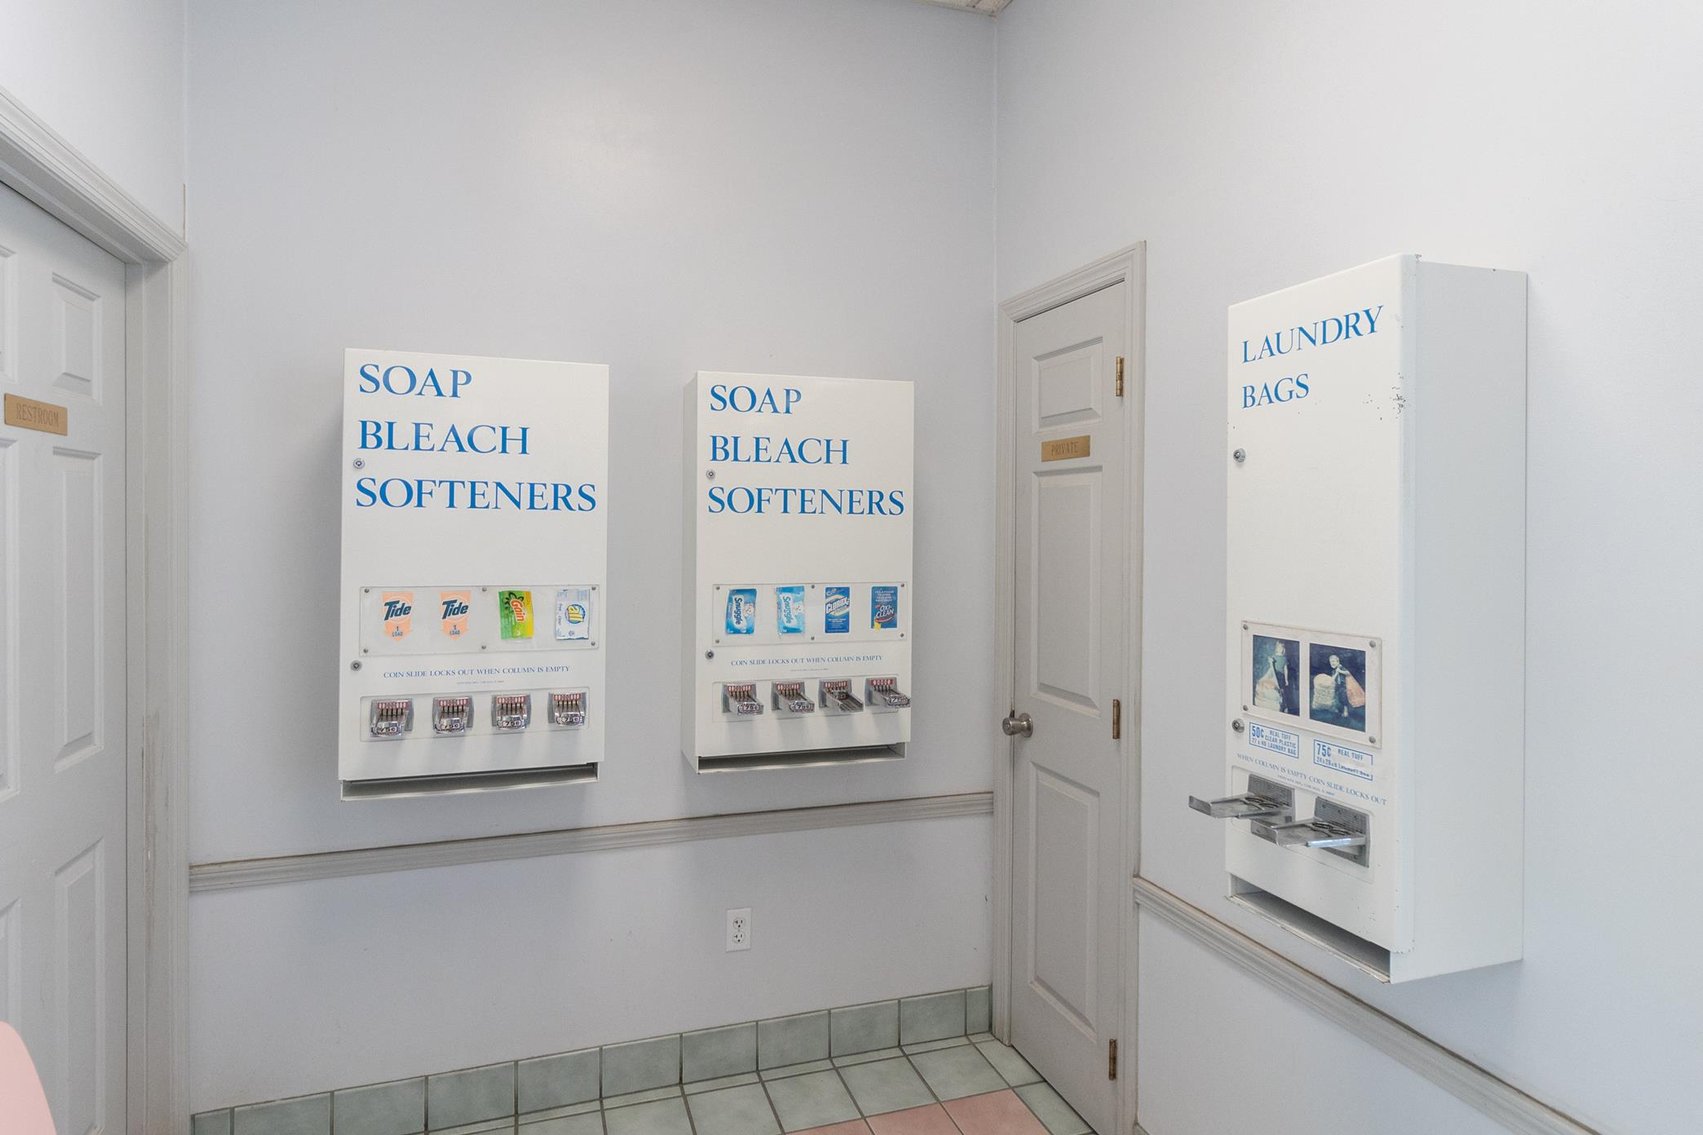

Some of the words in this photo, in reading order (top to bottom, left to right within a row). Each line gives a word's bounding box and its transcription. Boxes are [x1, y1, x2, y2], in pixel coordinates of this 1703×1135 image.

[1241, 304, 1384, 363] LAUNDRY
[359, 363, 472, 398] SOAP
[1241, 373, 1310, 409] BAGS
[709, 384, 802, 414] SOAP
[16, 402, 59, 427] RESTROOM
[358, 419, 530, 455] BLEACH
[709, 435, 849, 465] BLEACH
[355, 477, 597, 512] SOFTENERS
[708, 486, 905, 516] SOFTENERS
[384, 600, 412, 621] Tide
[441, 599, 469, 620] Tide
[510, 600, 526, 622] Gain
[734, 597, 744, 625] Snuggle
[782, 596, 793, 624] Snuggle
[383, 671, 404, 679] COIN
[405, 670, 427, 678] SLIDE
[430, 669, 456, 677] LOCKS
[457, 668, 475, 676] OUT
[476, 667, 500, 675] WHEN
[502, 666, 536, 674] COLUMN
[545, 665, 570, 673] EMPTY
[1251, 725, 1265, 739] 50¢
[1264, 735, 1278, 743] CLEAR
[1279, 739, 1296, 749] PLASTIC
[1316, 743, 1331, 757] 75¢
[1337, 748, 1350, 758] REAL
[1351, 752, 1364, 761] TUFF
[1236, 752, 1255, 762] WHEN
[1255, 758, 1280, 771] COLUMN
[1280, 765, 1286, 773] IS
[1287, 767, 1308, 780] EMPTY
[1309, 775, 1325, 786] COIN
[1327, 780, 1344, 792] SLIDE
[1345, 784, 1370, 800] LOCKS
[1371, 795, 1388, 806] OUT
